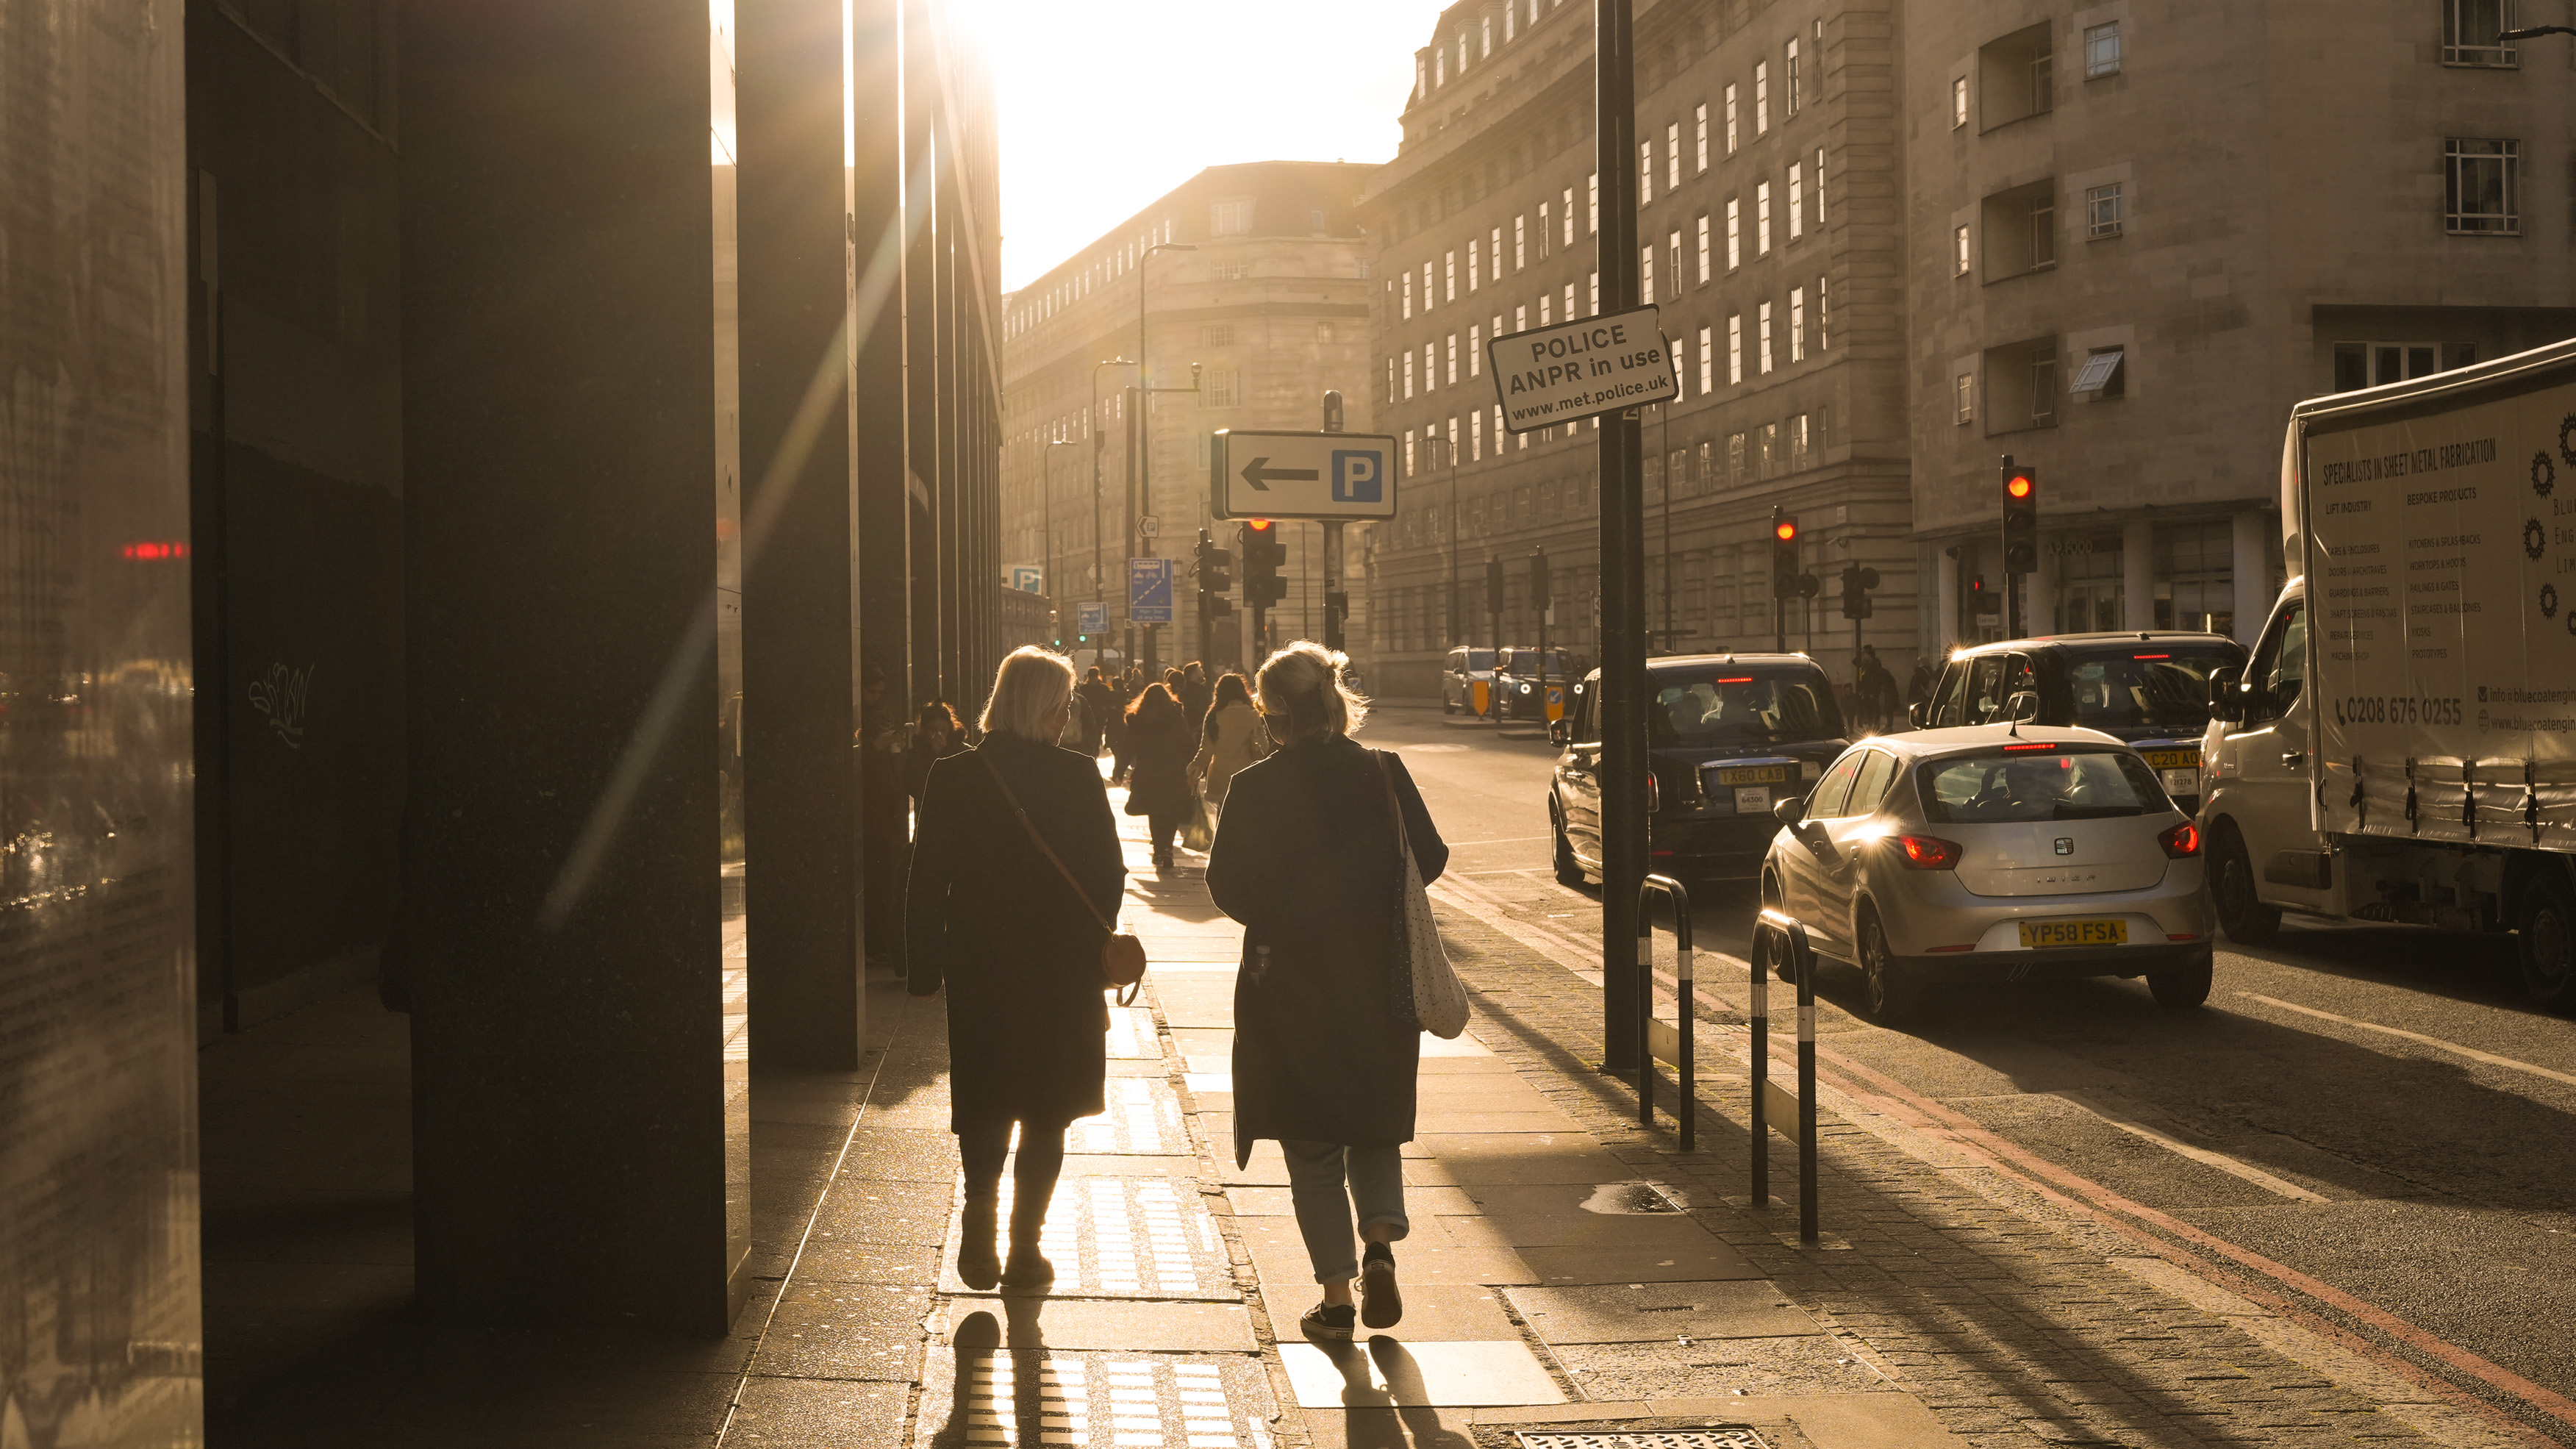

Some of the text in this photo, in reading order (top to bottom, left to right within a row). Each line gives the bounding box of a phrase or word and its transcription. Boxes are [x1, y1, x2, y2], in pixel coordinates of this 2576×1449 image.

[1531, 324, 1627, 362] POLICE
[1510, 349, 1660, 395] ANPR in use
[1512, 376, 1669, 421] www.met.police.uk
[2323, 437, 2496, 486] SPECIALISTS IN SHEET METAL FABRICATION
[1345, 457, 1374, 497] P
[2407, 487, 2477, 506] BESPOKE PRODUCTS
[2326, 500, 2372, 515] LIFT INDUSTRY
[2554, 498, 2576, 516] BLU
[2408, 537, 2435, 549] KITCHENS
[2328, 568, 2347, 577] DOORS
[2409, 559, 2440, 571] WORKTOPS
[2441, 581, 2459, 591] GATES
[2412, 648, 2447, 659] PROTOTYPES
[2347, 696, 2461, 726] 0208 676 0255
[2182, 752, 2200, 765] AO
[1721, 768, 1783, 781] TX60 CAB
[2028, 923, 2119, 942] YP58 FSA
